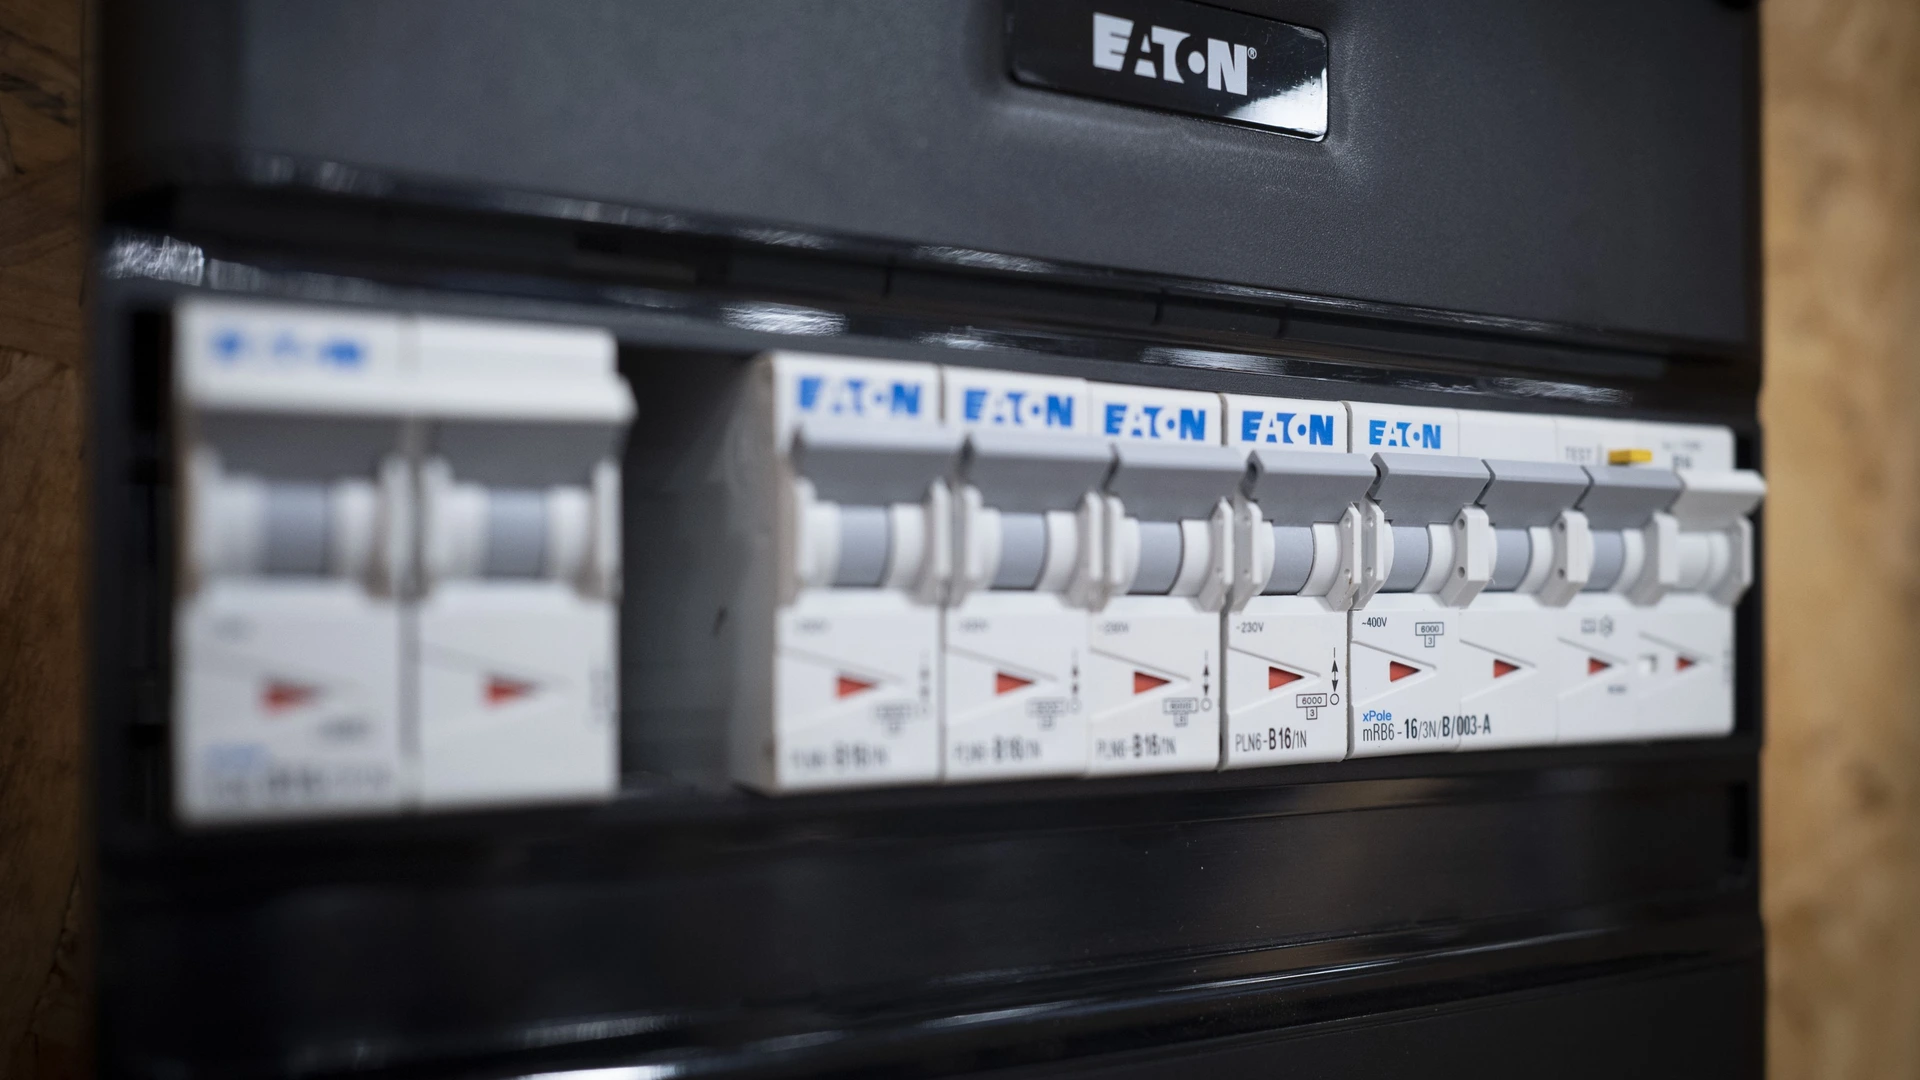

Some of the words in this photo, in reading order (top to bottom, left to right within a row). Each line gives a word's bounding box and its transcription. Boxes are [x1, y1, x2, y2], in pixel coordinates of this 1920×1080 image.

[797, 376, 922, 417] EATON
[964, 388, 1075, 428] EATON
[1104, 404, 1206, 441] EATON
[1241, 410, 1334, 446] EATON
[1369, 419, 1442, 450] EATON
[1420, 624, 1440, 634] 6000
[1427, 637, 1433, 645] 3
[1301, 696, 1323, 706] 6000
[1309, 709, 1315, 717] 3
[1362, 710, 1392, 723] xPole
